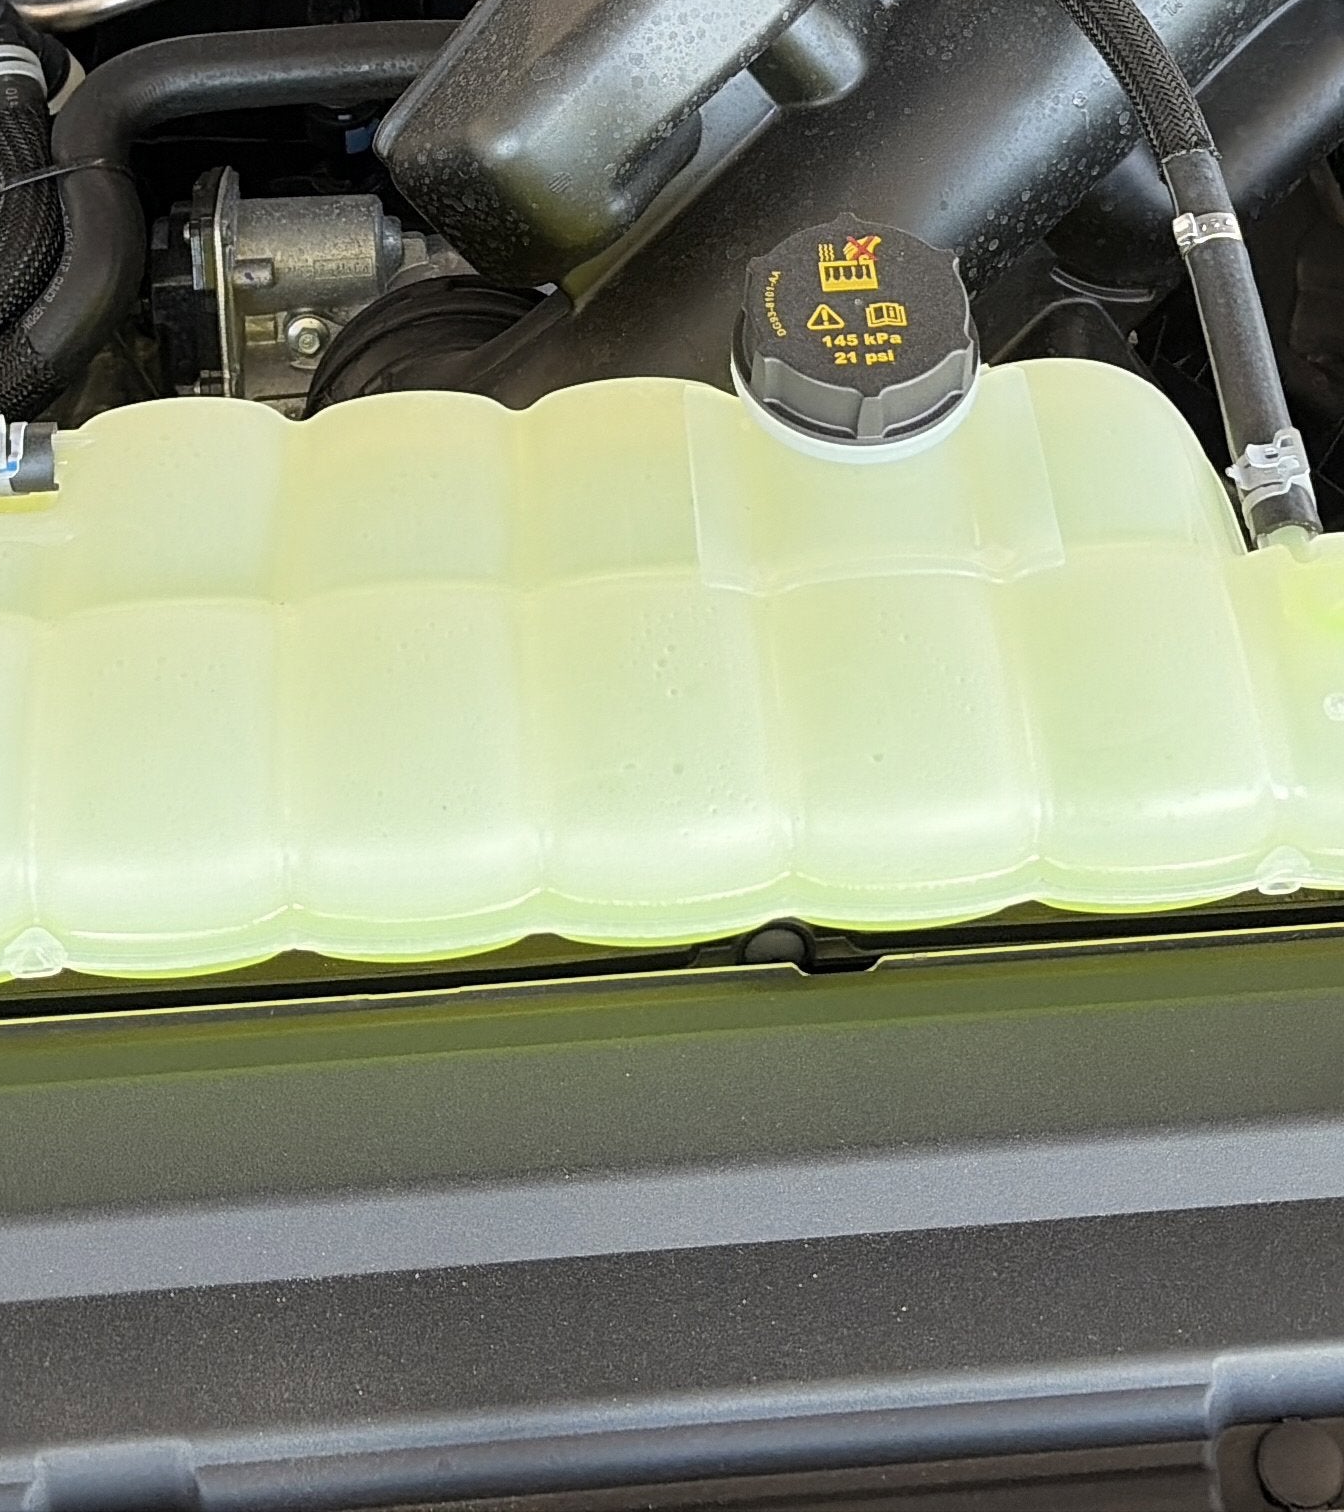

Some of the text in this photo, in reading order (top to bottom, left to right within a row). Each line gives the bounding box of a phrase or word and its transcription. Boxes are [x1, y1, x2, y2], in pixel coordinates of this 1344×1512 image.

[821, 332, 902, 348] 145 kPa
[834, 349, 895, 366] 21 psi
